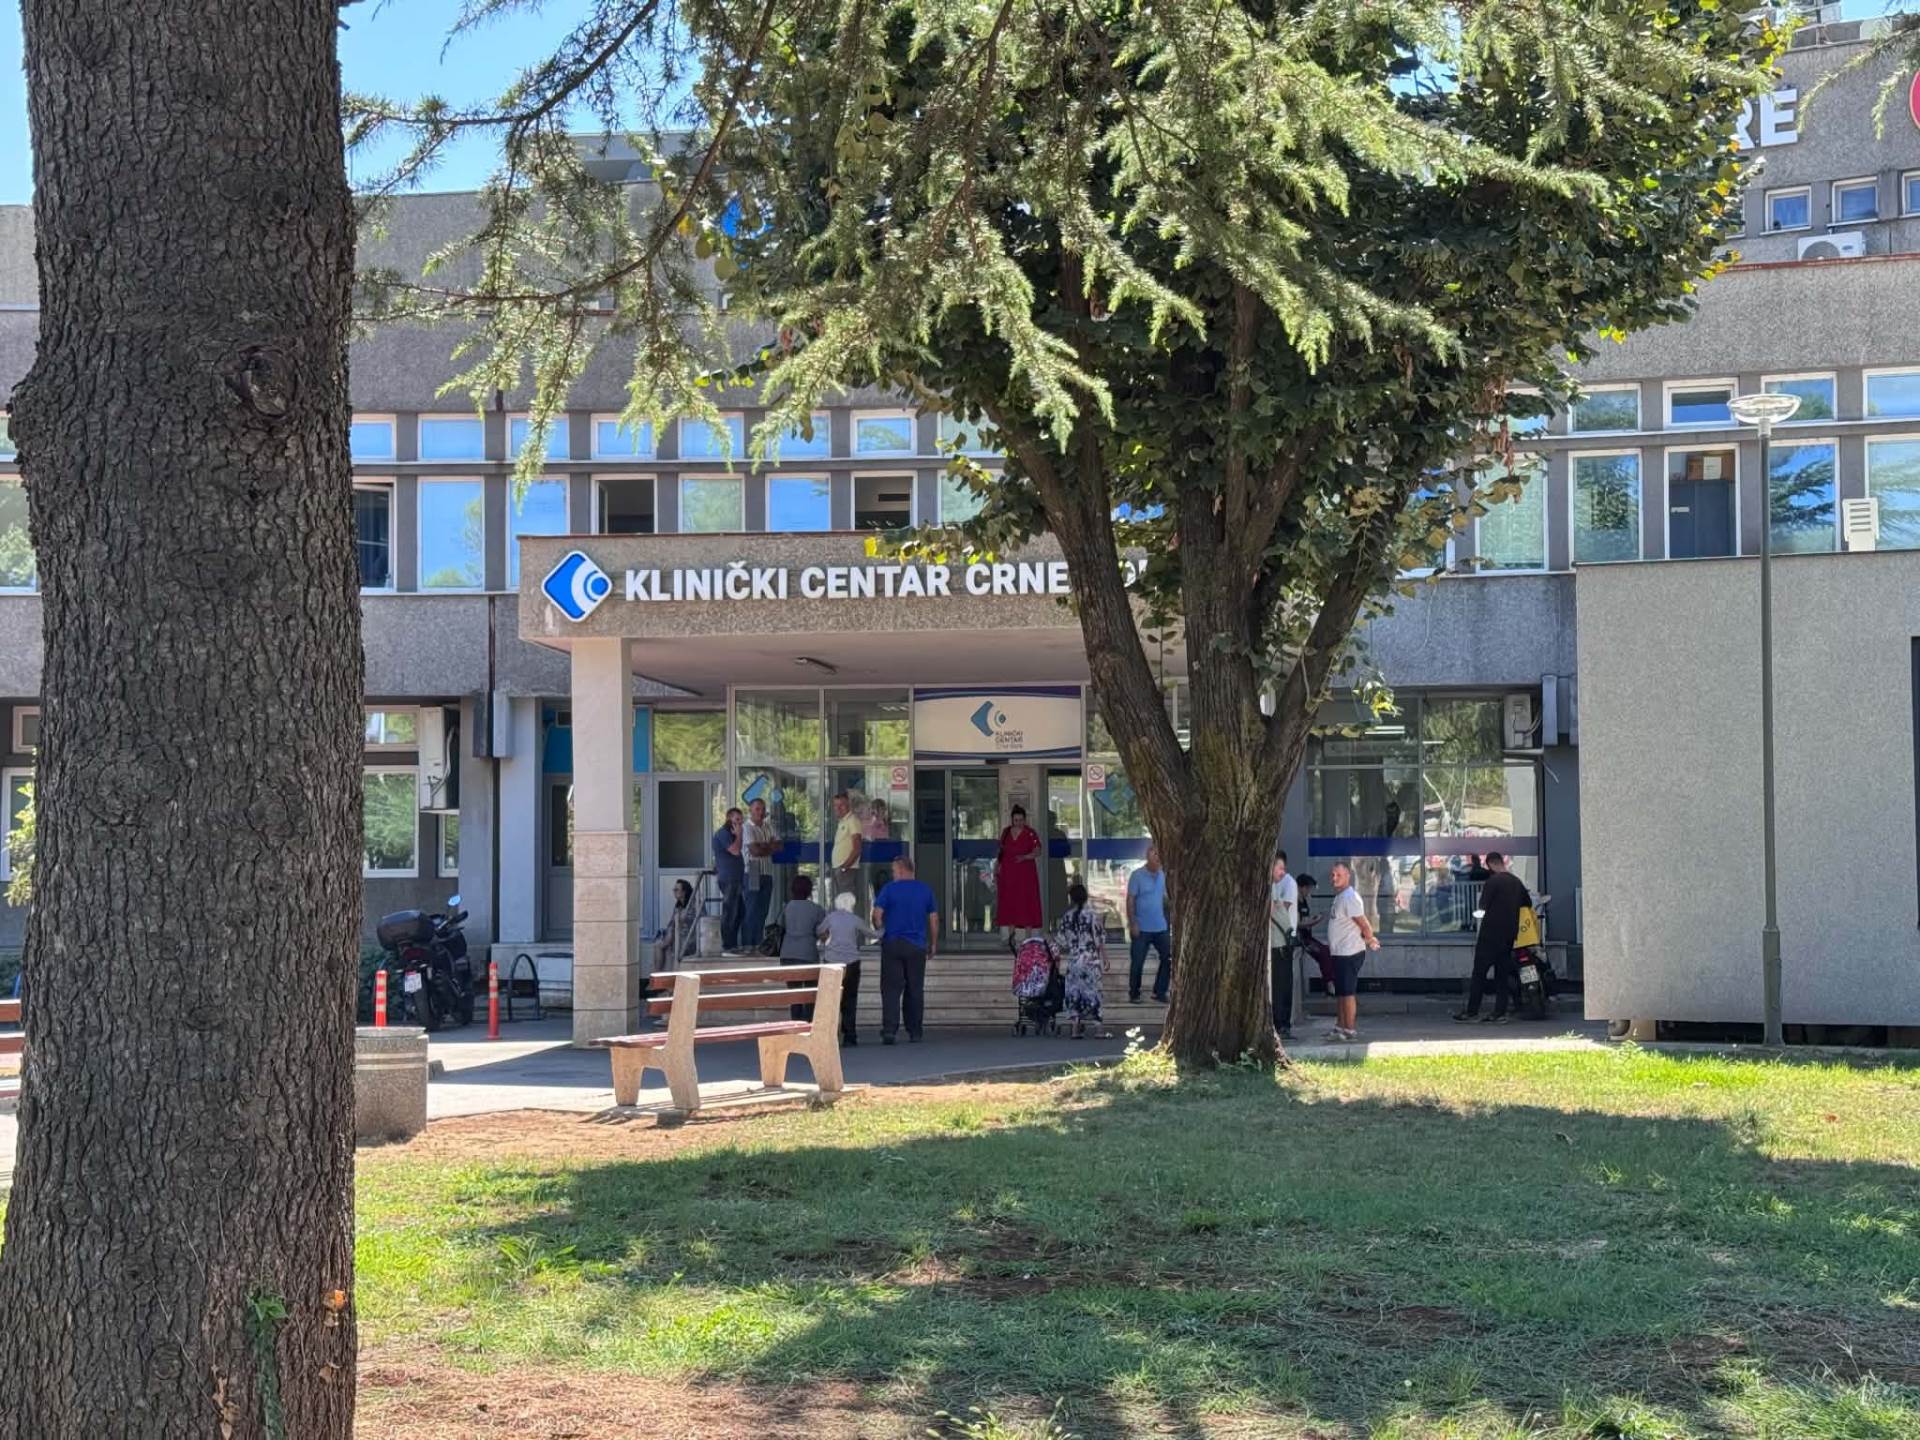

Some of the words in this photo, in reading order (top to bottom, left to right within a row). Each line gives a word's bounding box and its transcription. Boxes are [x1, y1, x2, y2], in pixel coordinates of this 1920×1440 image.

[1735, 89, 1798, 149] RE
[625, 561, 788, 601] KLINIČKI
[800, 565, 952, 599] CENTAR
[965, 561, 1072, 596] CRNE
